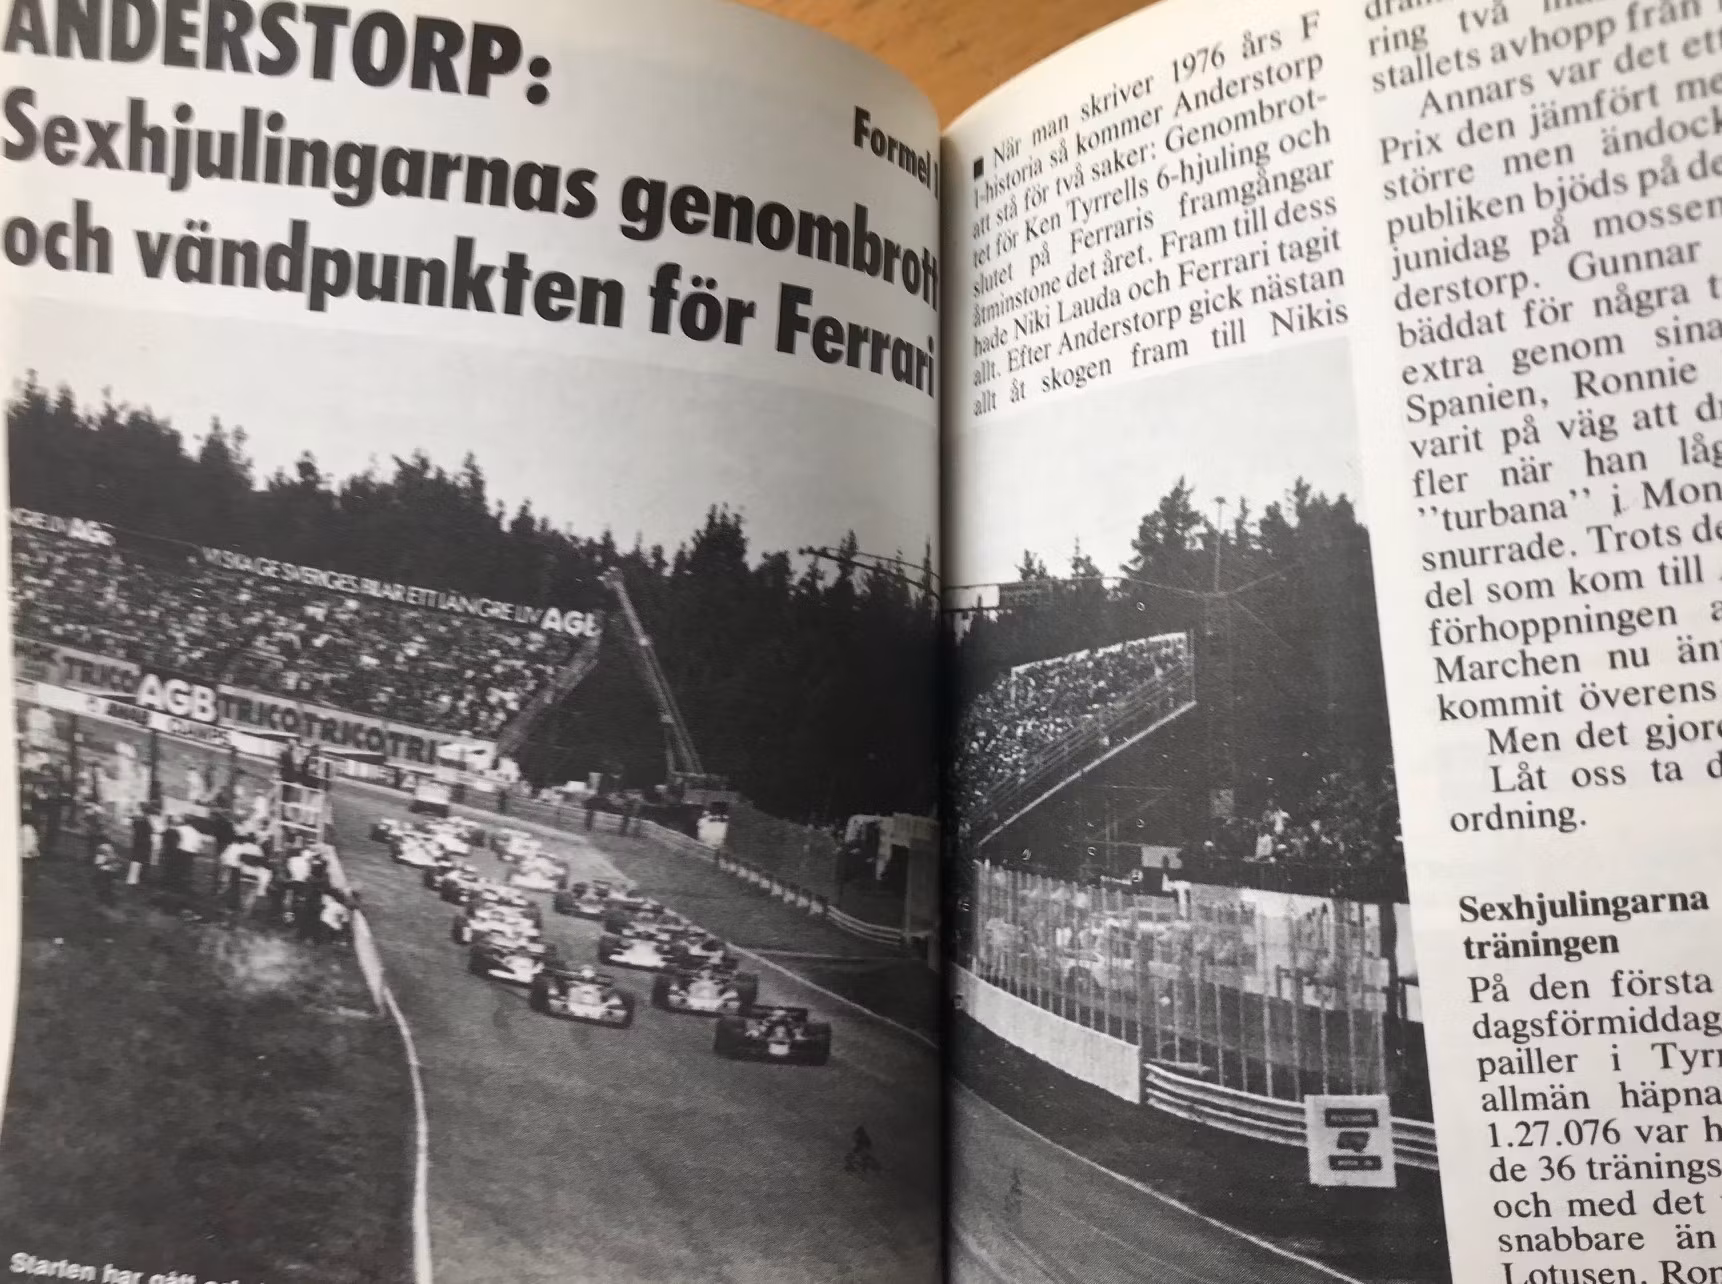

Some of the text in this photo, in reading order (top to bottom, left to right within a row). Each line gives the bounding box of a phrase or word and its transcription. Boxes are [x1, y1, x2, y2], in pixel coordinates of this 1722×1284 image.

[2, 0, 552, 106] ANDERSTORP:
[1368, 0, 1509, 57] ring två
[1372, 0, 1702, 93] stallets avhopp från
[993, 9, 1320, 168] När man skriver 1976 års F
[1420, 40, 1670, 119] Annars var det
[1050, 138, 1068, 168] så
[1076, 103, 1163, 155] kommer
[1174, 53, 1323, 119] Anderstorp
[1379, 82, 1660, 165] Prix den jämfört
[854, 105, 931, 191] Formel
[973, 88, 1328, 241] att stå för två saker: Genombrot-
[1383, 162, 1475, 200] större
[1503, 144, 1574, 177] men
[2, 86, 938, 311] Sexhjulingarnas genombrott
[973, 118, 1331, 269] tet för Ken Tyrrells 6-hjuling och
[1386, 153, 1680, 245] publiken bjöds på
[973, 158, 1334, 298] slutet på Ferraris framgångar
[1391, 195, 1722, 281] junidag på mossen
[973, 195, 1338, 329] åtminstone det året. Fram till dess
[1393, 241, 1702, 312] derstorp. Gunnar
[2, 199, 934, 398] och vändpunkten för Ferrari
[973, 226, 1342, 358] hade Niki Lauda och Ferrari tagit
[1398, 282, 1691, 349] bäddat för några
[973, 266, 1345, 387] allt. Efter Anderstorp gick nästan
[1401, 314, 1722, 386] extra genom sina
[973, 298, 1349, 417] allt åt skogen fram till Nikis
[1405, 356, 1699, 426] Spanien, Ronnie
[1410, 400, 1680, 459] varit på väg att
[1412, 468, 1469, 498] fler
[1500, 456, 1553, 488] när
[1584, 447, 1649, 477] han
[1611, 483, 1623, 516] i
[1641, 477, 1722, 510] Mon
[1422, 522, 1682, 573] snurrade. Trots
[1425, 553, 1704, 609] del som kom till
[1428, 603, 1678, 648] förhoppningen
[1433, 646, 1650, 684] Marchen nu
[136, 674, 217, 723] AGB
[1438, 680, 1718, 722] kommit överens
[1487, 720, 1630, 757] Men det
[1489, 757, 1684, 793] Låt oss ta
[1450, 801, 1588, 834] ordning.
[1459, 890, 1709, 926] Sexhjulingarna
[1463, 930, 1620, 962] träningen
[1467, 969, 1714, 1004] På den första
[1472, 1005, 1722, 1044] dagsförmiddag
[1476, 1046, 1578, 1083] pailler
[1611, 1043, 1621, 1072] i
[1481, 1080, 1722, 1114] allmän häpna
[1487, 1117, 1689, 1148] 1.27.076 var
[1489, 1152, 1722, 1185] de 36 tränings
[1493, 1188, 1706, 1219] och med det
[1498, 1223, 1717, 1254] snabbare än
[10, 1252, 144, 1284] Starten har
